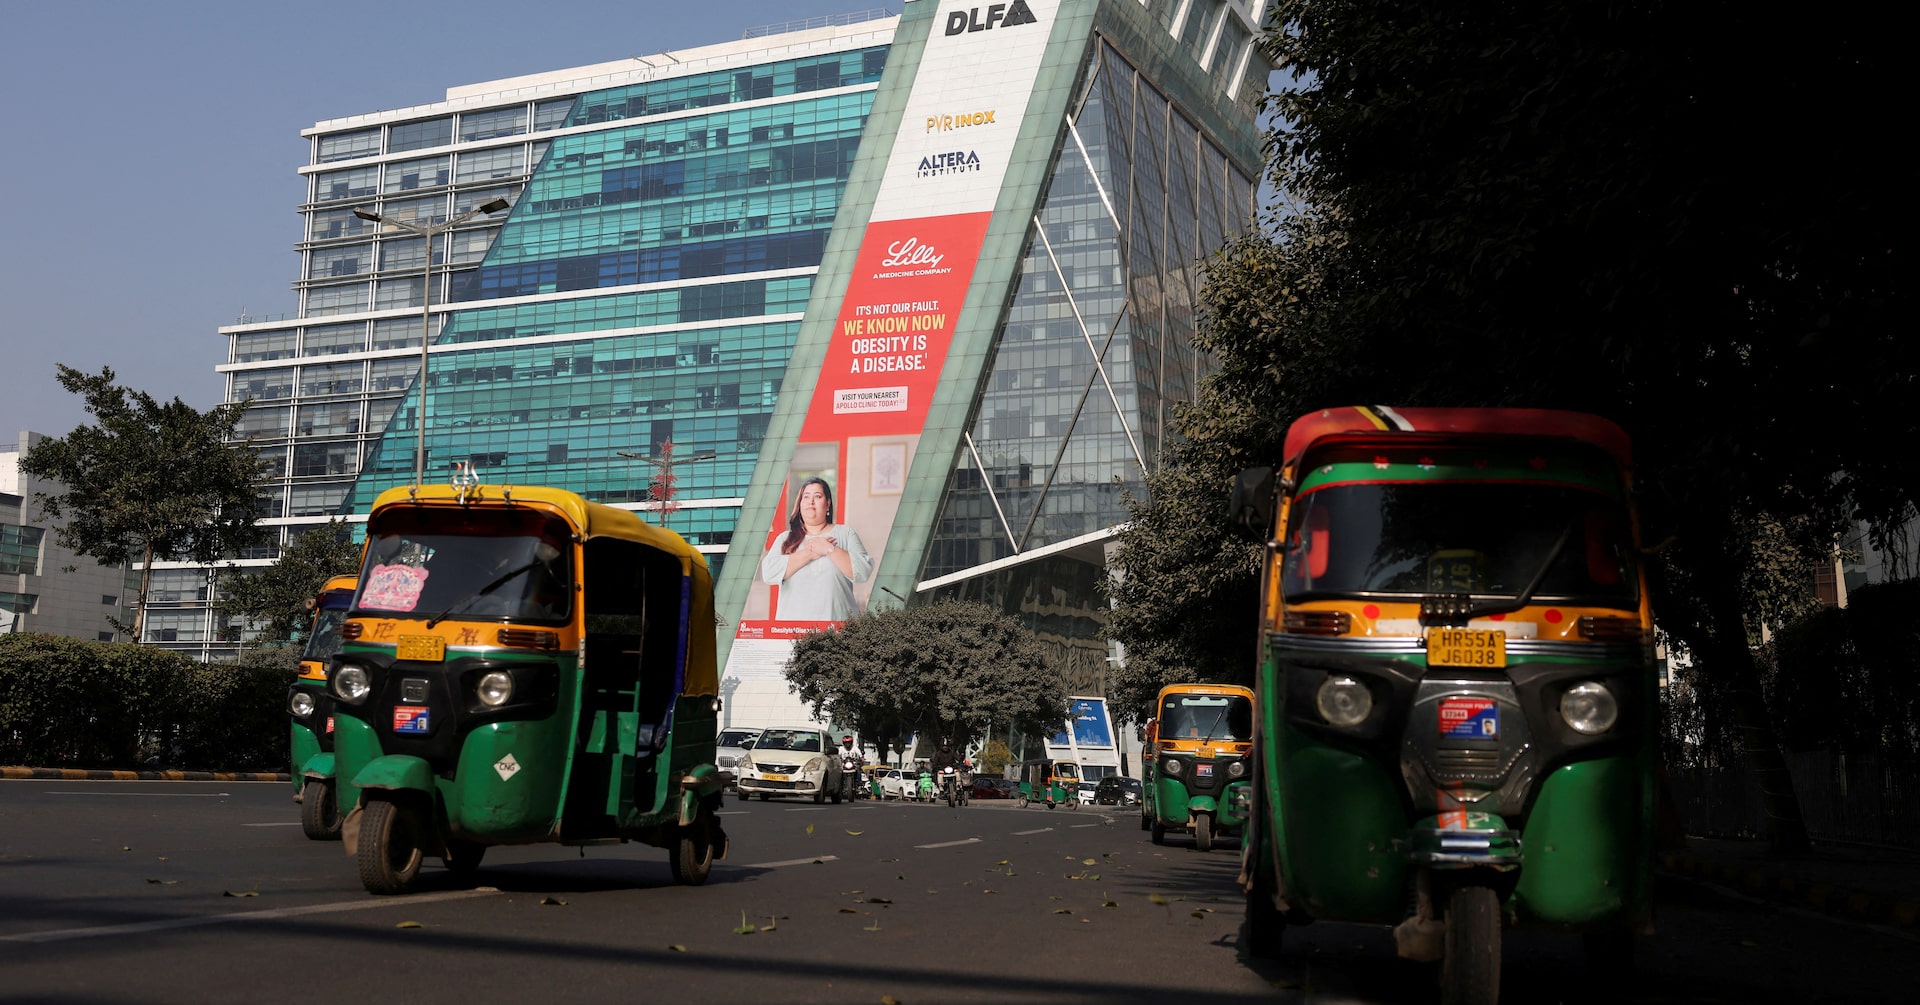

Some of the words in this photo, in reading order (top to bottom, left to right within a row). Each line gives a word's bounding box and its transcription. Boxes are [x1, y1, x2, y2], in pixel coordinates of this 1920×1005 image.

[945, 3, 1006, 37] DLF
[926, 113, 953, 134] PVR
[955, 110, 996, 129] INOX
[918, 150, 980, 171] ALTERA
[917, 164, 981, 178] INSTITUTE
[881, 237, 945, 268] Lilly
[879, 270, 914, 279] MEDICINE
[914, 267, 952, 277] COMPANY
[855, 303, 872, 316] IT'S
[873, 303, 890, 315] NOT
[891, 301, 911, 313] OUR
[911, 300, 939, 312] FAULT.
[843, 319, 864, 336] WE
[866, 316, 909, 335] KNOW
[911, 313, 946, 331] NOW
[851, 335, 909, 355] OBESITY
[913, 334, 927, 350] IS
[850, 358, 860, 374] A
[841, 393, 857, 401] VISIT
[857, 392, 873, 400] YOUR
[873, 391, 900, 399] NEAREST
[1442, 631, 1496, 648] HR55A
[1442, 649, 1495, 665] J6038
[499, 762, 515, 771] CNG
